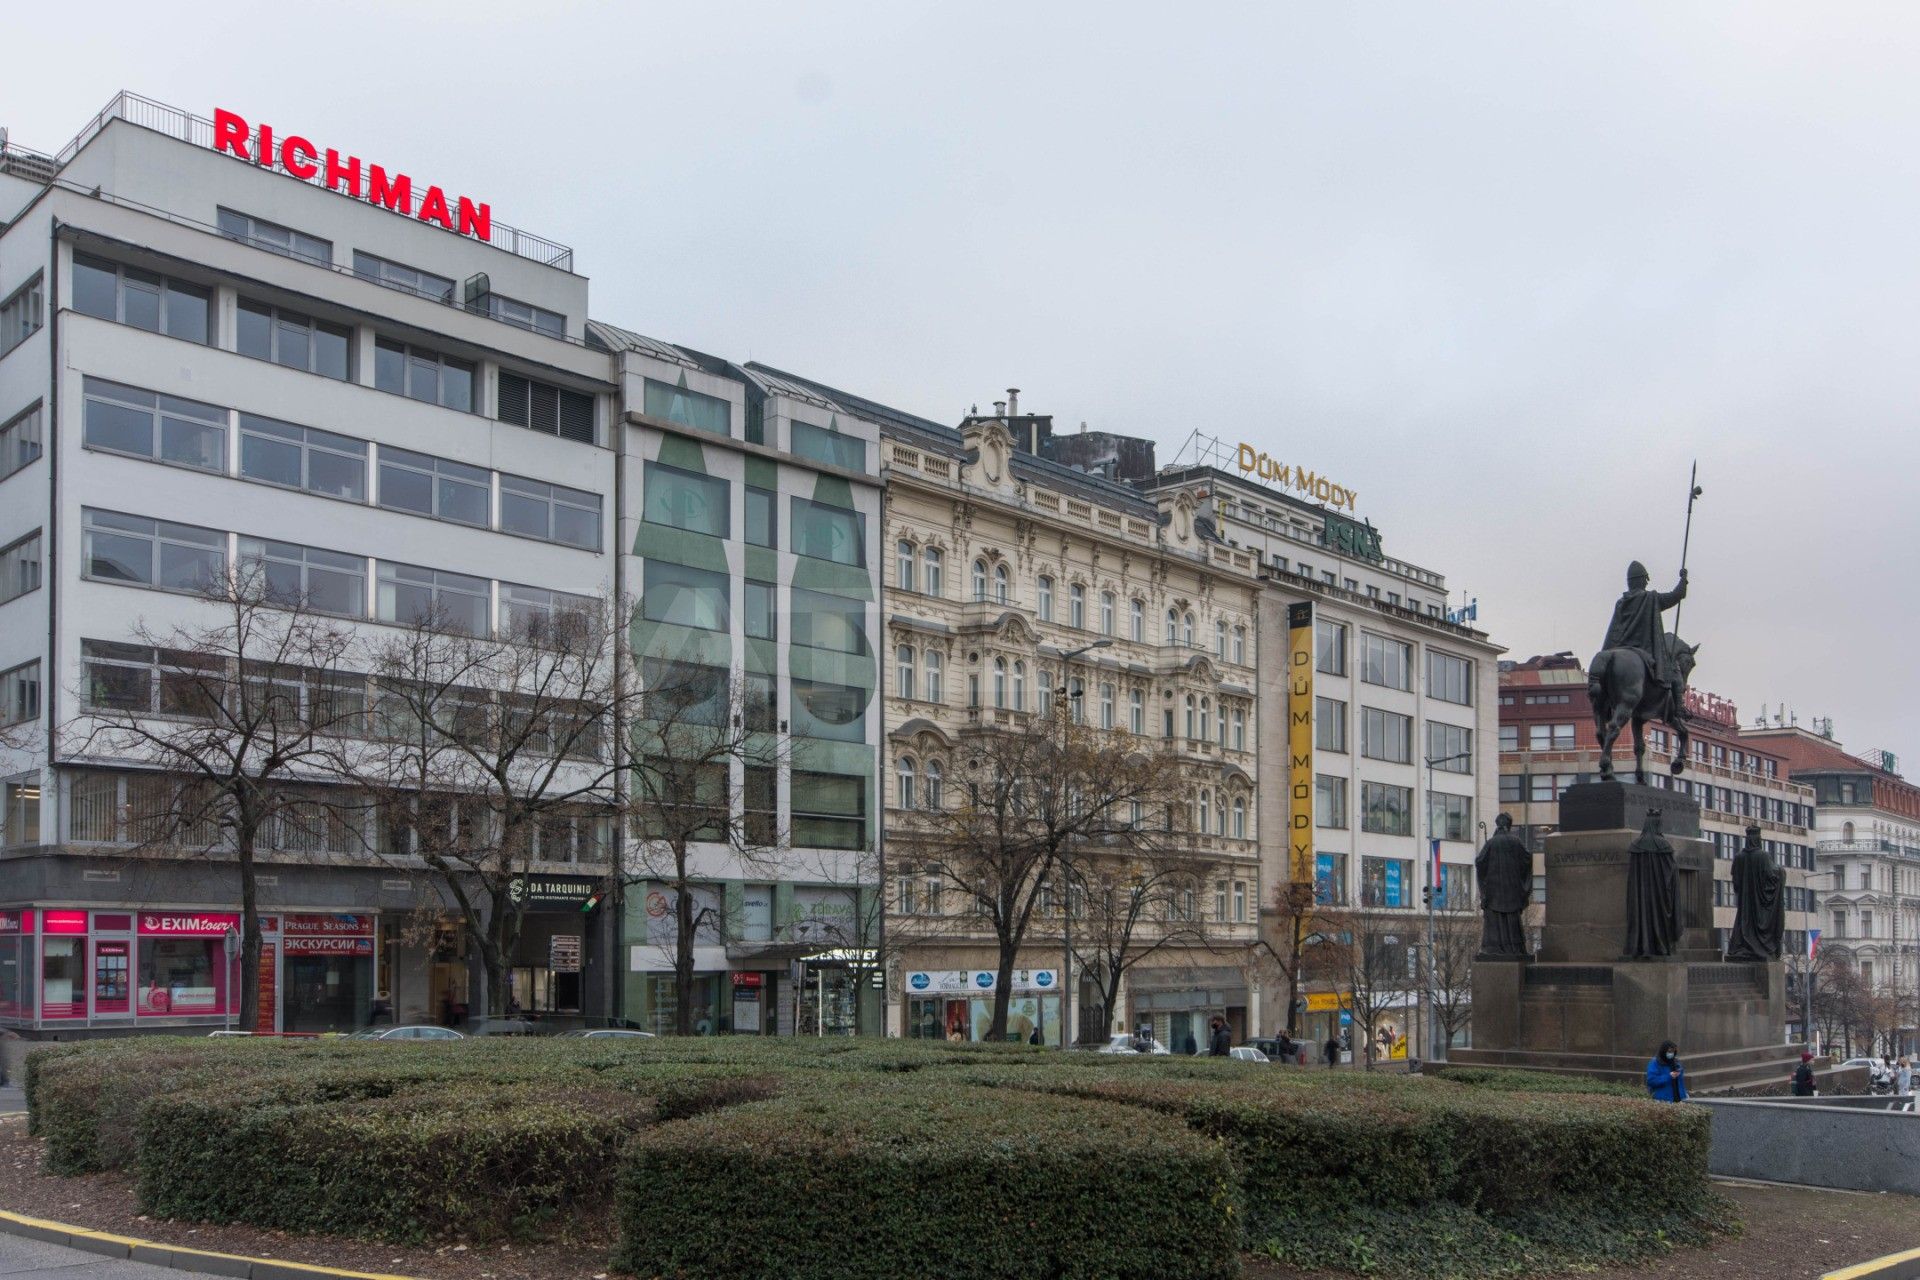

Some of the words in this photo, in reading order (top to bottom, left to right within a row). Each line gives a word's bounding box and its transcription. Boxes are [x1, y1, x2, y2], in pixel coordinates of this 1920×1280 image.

[213, 106, 491, 242] RICHMAN
[1238, 442, 1290, 487] DŮM
[1296, 465, 1358, 511] MÓDY
[530, 883, 542, 893] DA
[545, 883, 591, 894] TARQUINIO
[284, 921, 319, 931] PRAGUE
[323, 921, 359, 931] SEASONS
[284, 939, 355, 951] ЭКСКУРСИИ
